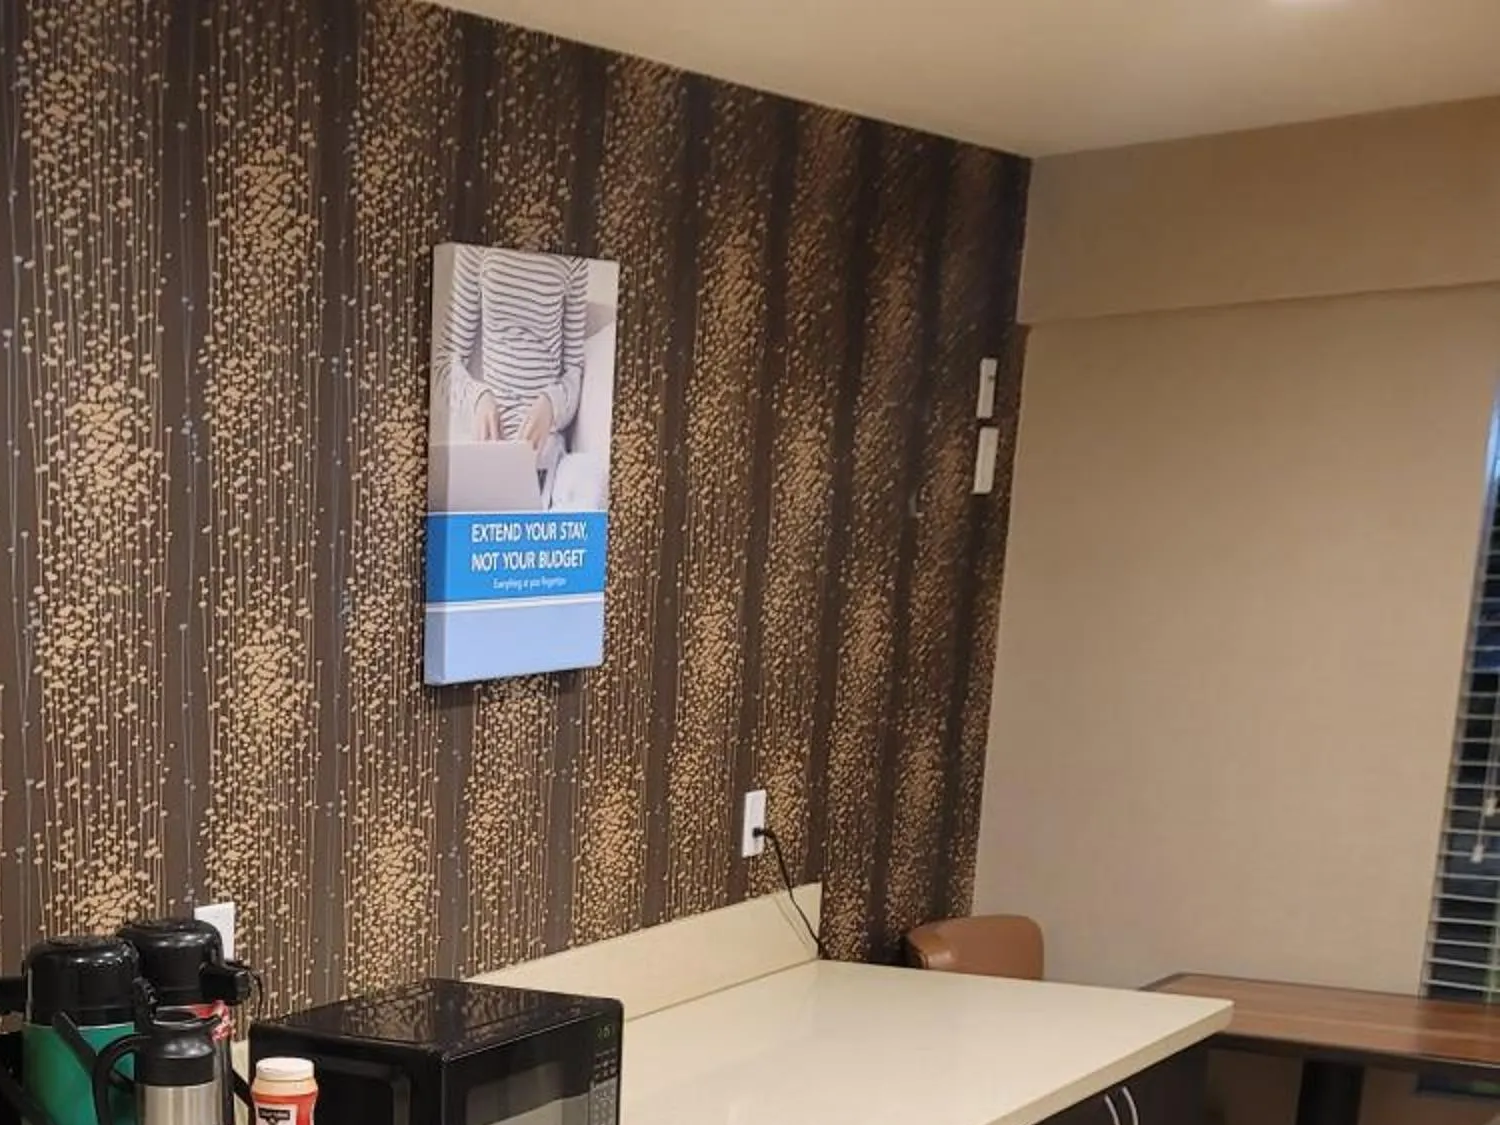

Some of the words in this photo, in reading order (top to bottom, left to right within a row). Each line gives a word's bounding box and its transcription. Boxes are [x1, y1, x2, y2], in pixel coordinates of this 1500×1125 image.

[471, 523, 521, 543] EXTEND
[525, 521, 557, 541] YOUR
[471, 551, 500, 573] NOT
[502, 550, 536, 571] YOUR
[538, 548, 587, 569] BUDGET
